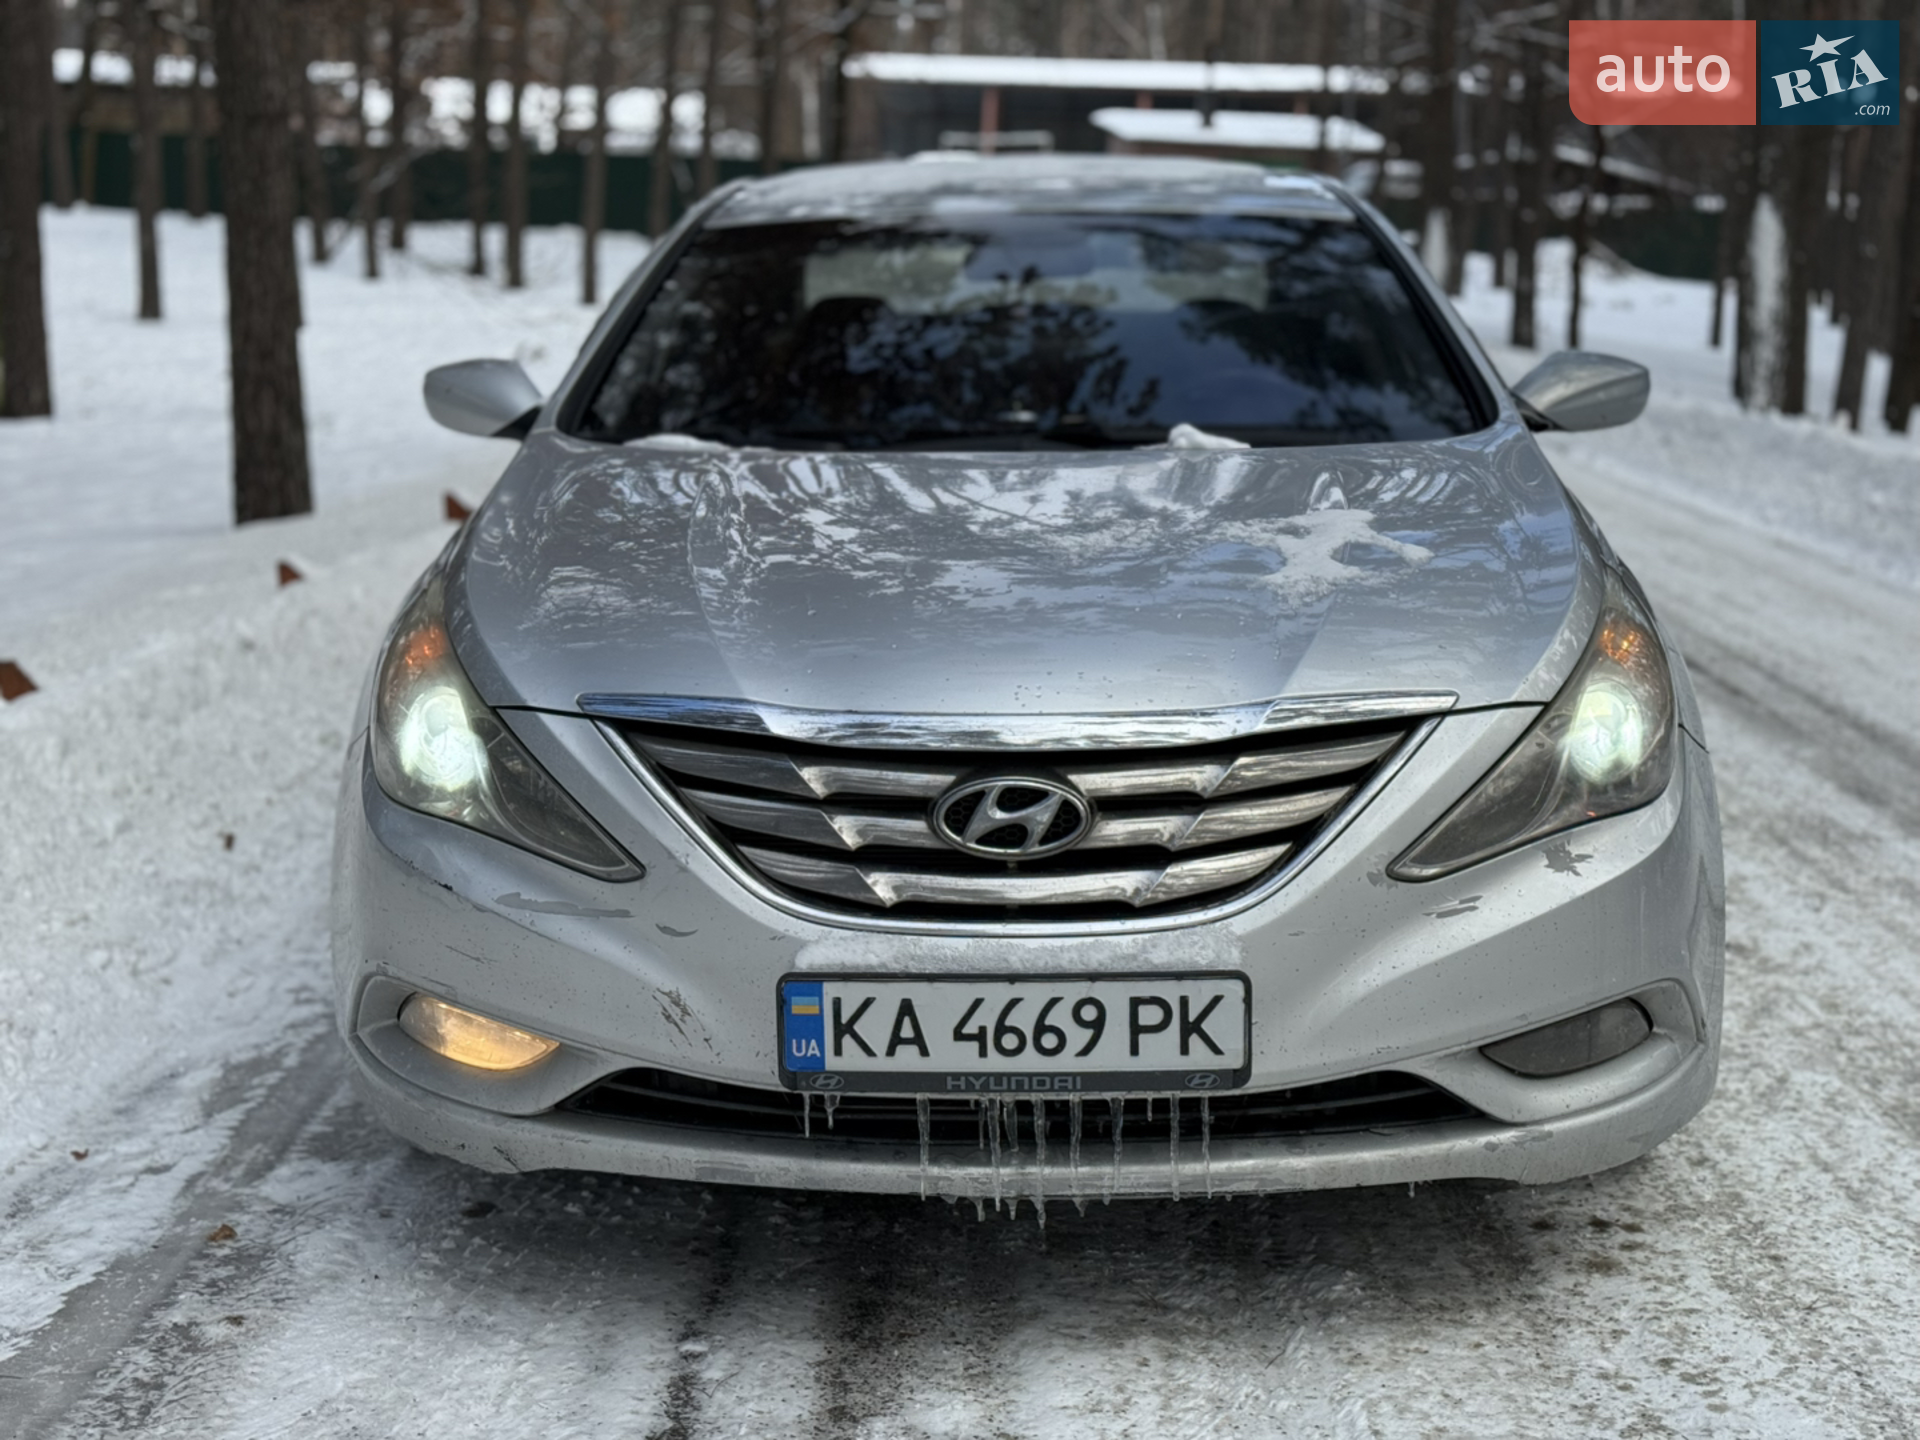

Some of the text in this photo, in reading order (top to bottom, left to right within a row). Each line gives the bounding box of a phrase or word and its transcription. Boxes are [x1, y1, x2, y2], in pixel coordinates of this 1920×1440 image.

[832, 995, 1225, 1058] KA 4669 PK
[791, 1039, 821, 1058] UA
[946, 1075, 1082, 1091] HYUNDAI
